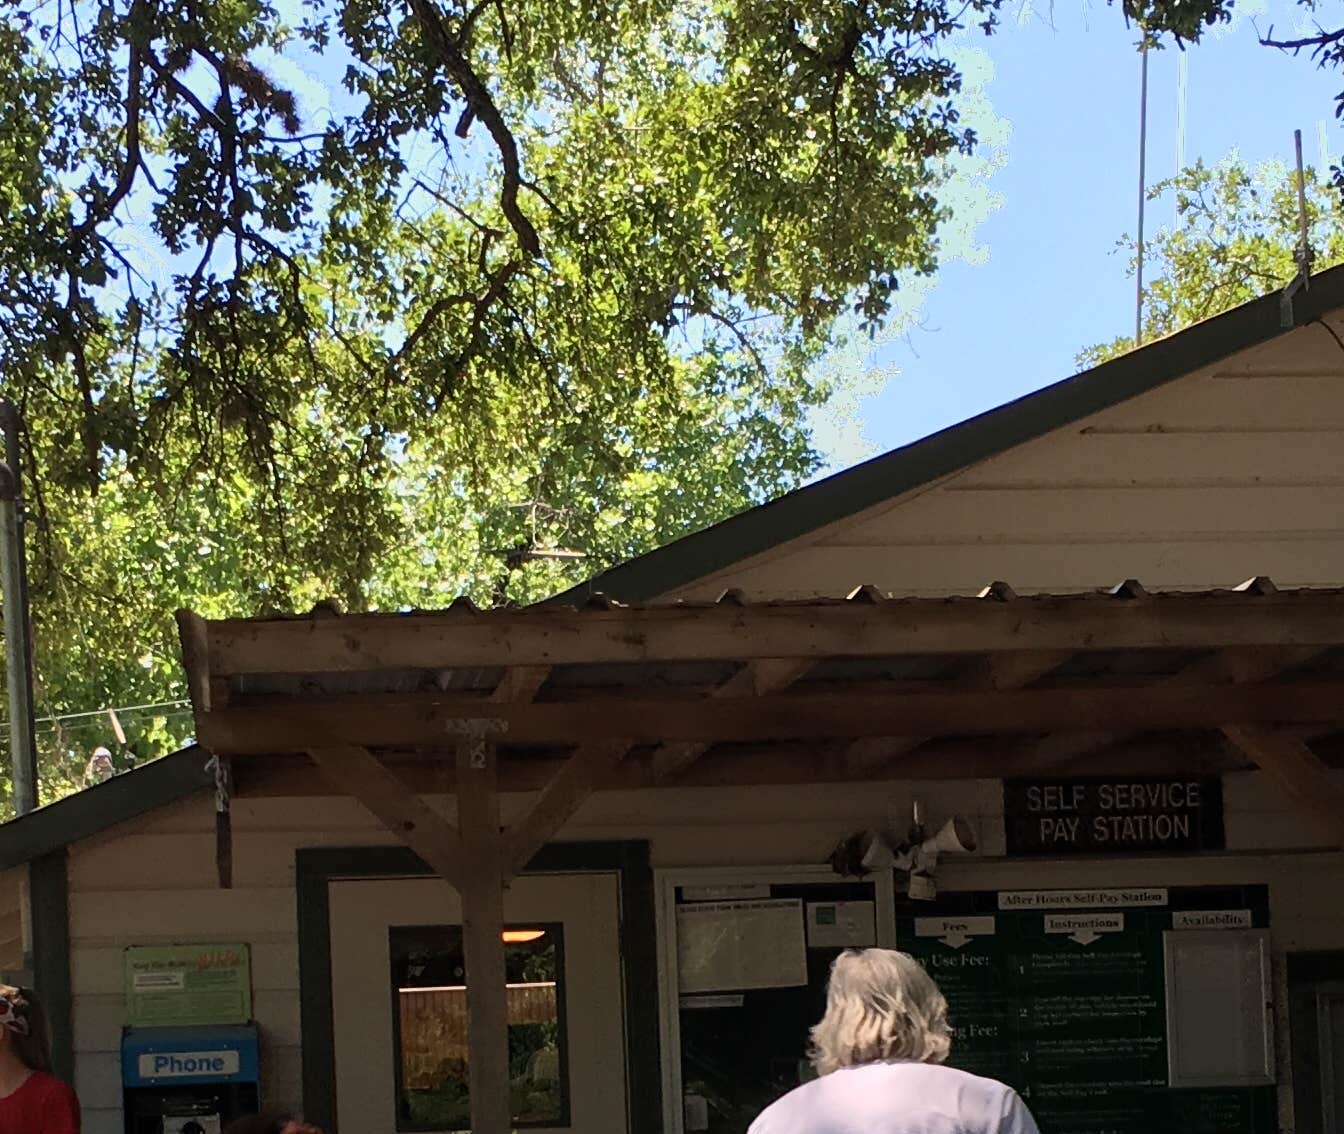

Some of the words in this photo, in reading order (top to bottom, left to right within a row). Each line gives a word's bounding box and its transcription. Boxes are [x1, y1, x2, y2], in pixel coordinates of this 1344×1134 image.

[1026, 784, 1085, 811] SELF
[1097, 781, 1200, 810] SERVICE
[1040, 817, 1080, 841] PAY
[1093, 814, 1189, 841] STATION
[1005, 893, 1033, 905] After
[1036, 893, 1070, 905] Hours
[1122, 891, 1162, 903] Station
[942, 921, 969, 932] Fees
[1049, 917, 1120, 930] Instructions
[931, 953, 957, 968] Use
[961, 953, 990, 967] Fee:
[969, 1024, 999, 1038] Fee:
[153, 1055, 225, 1073] Phone
